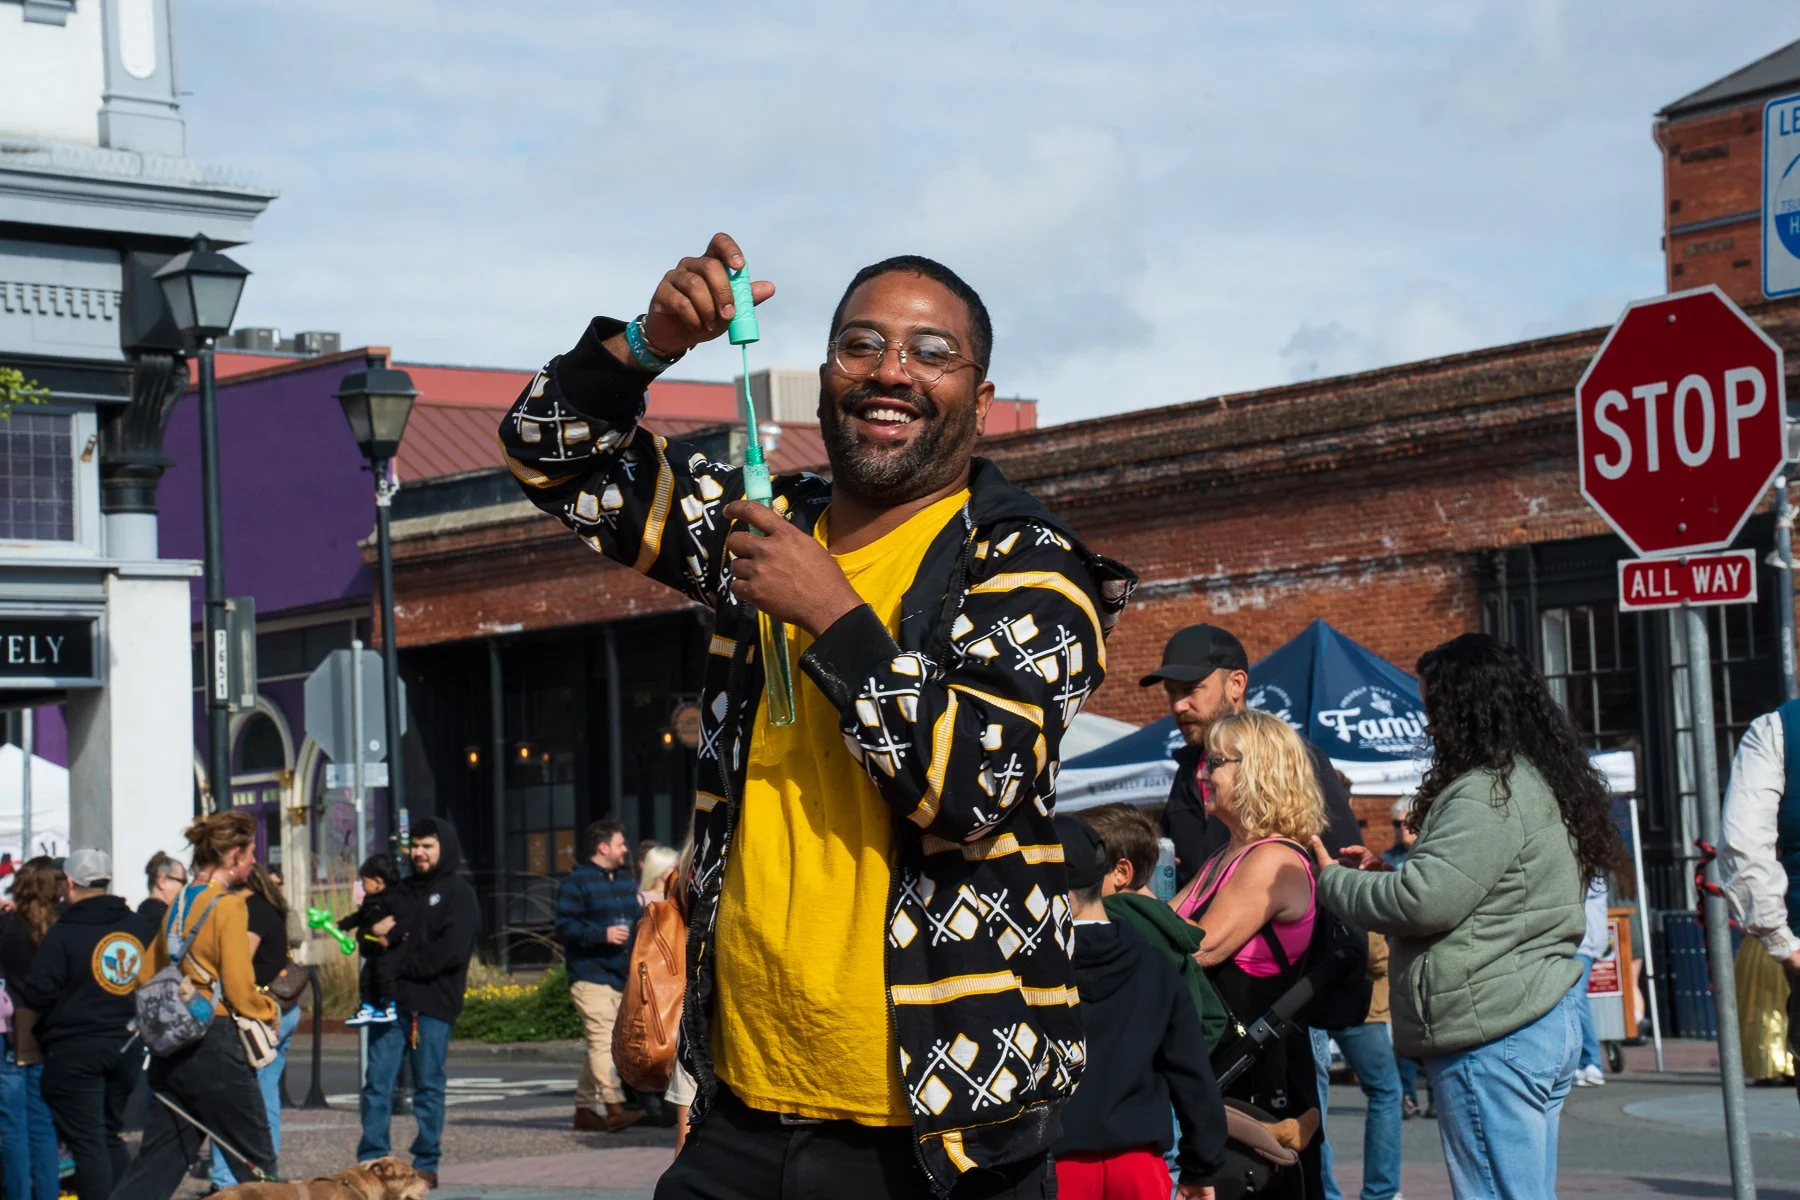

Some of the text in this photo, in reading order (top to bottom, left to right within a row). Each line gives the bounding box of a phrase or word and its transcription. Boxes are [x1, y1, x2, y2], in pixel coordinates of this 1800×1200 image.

[1779, 106, 1800, 136] LE
[1594, 366, 1767, 480] STOP
[1631, 563, 1742, 598] ALL WAY
[0, 635, 65, 664] ELY
